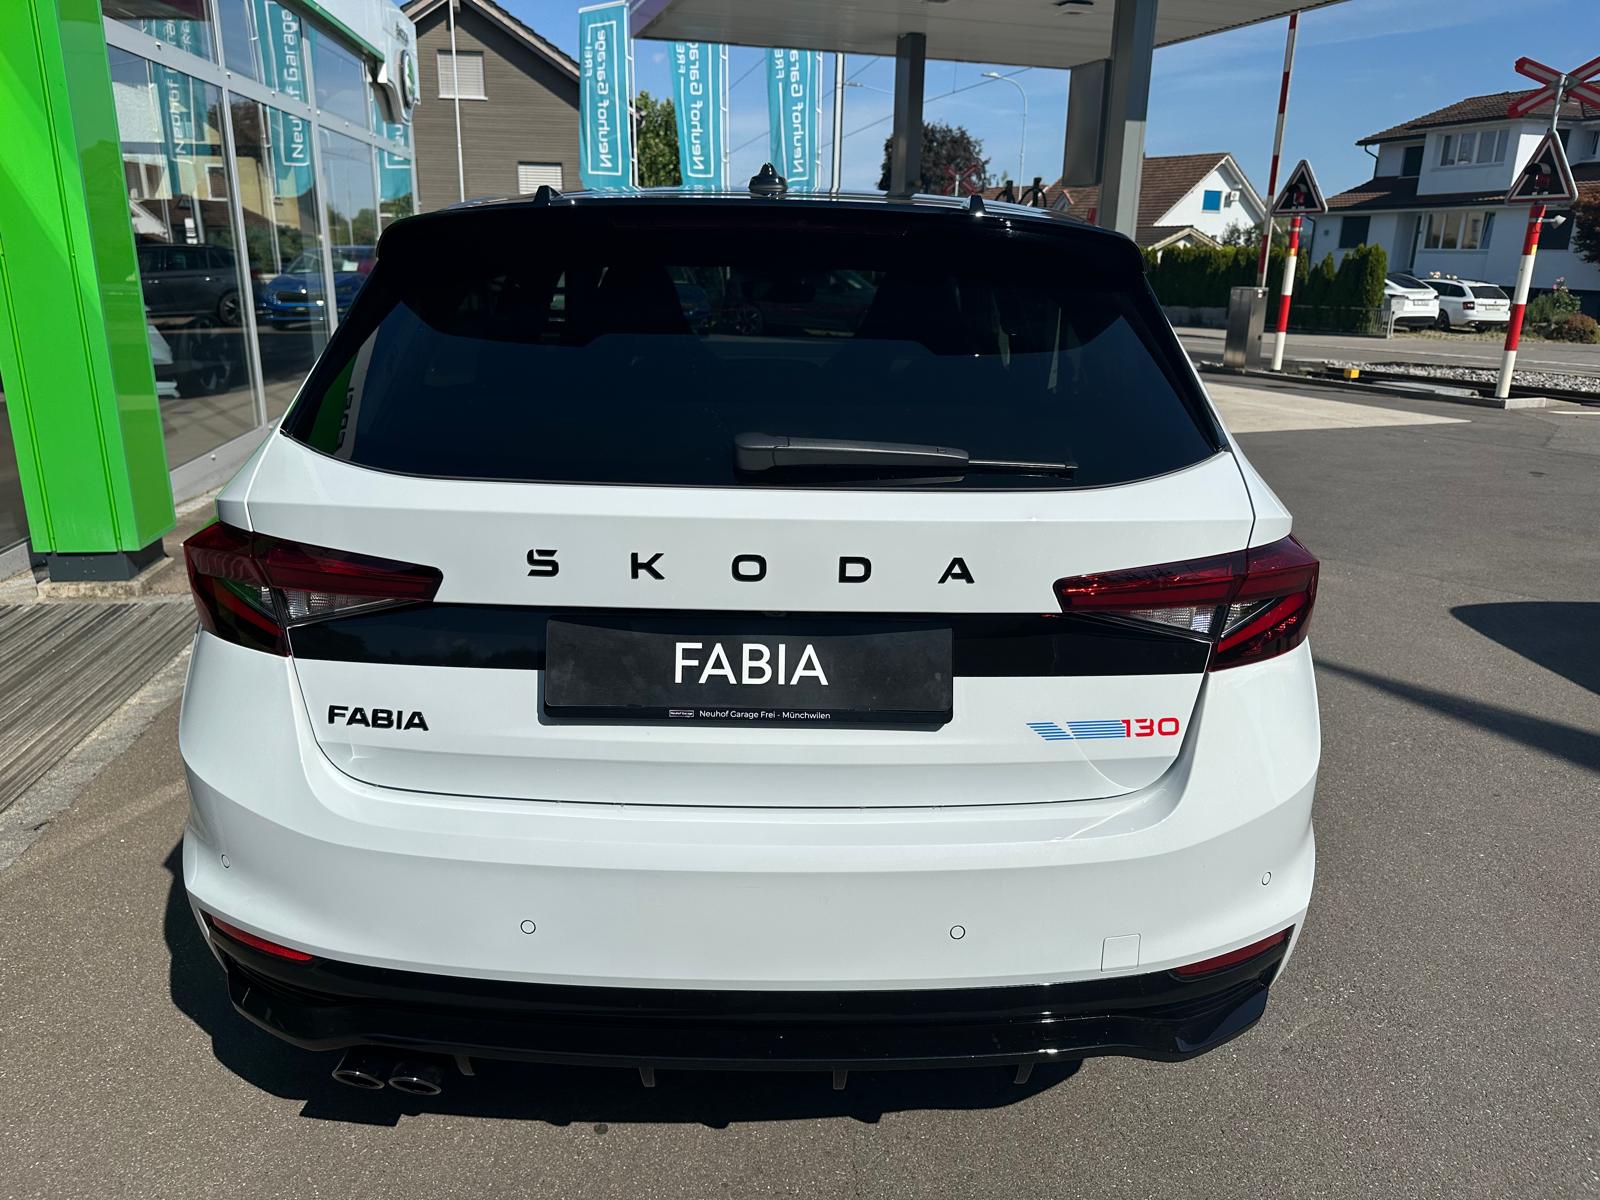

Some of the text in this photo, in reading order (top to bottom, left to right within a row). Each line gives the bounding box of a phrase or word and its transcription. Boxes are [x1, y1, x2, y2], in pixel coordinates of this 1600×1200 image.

[282, 9, 304, 158] Neuf Garage
[673, 642, 829, 686] FABIA
[327, 704, 430, 732] FABIA
[699, 710, 729, 718] Neuhof
[730, 710, 759, 720] Garage
[760, 710, 776, 719] Frei
[782, 711, 831, 720] Münchwilen
[1121, 717, 1180, 737] 130
